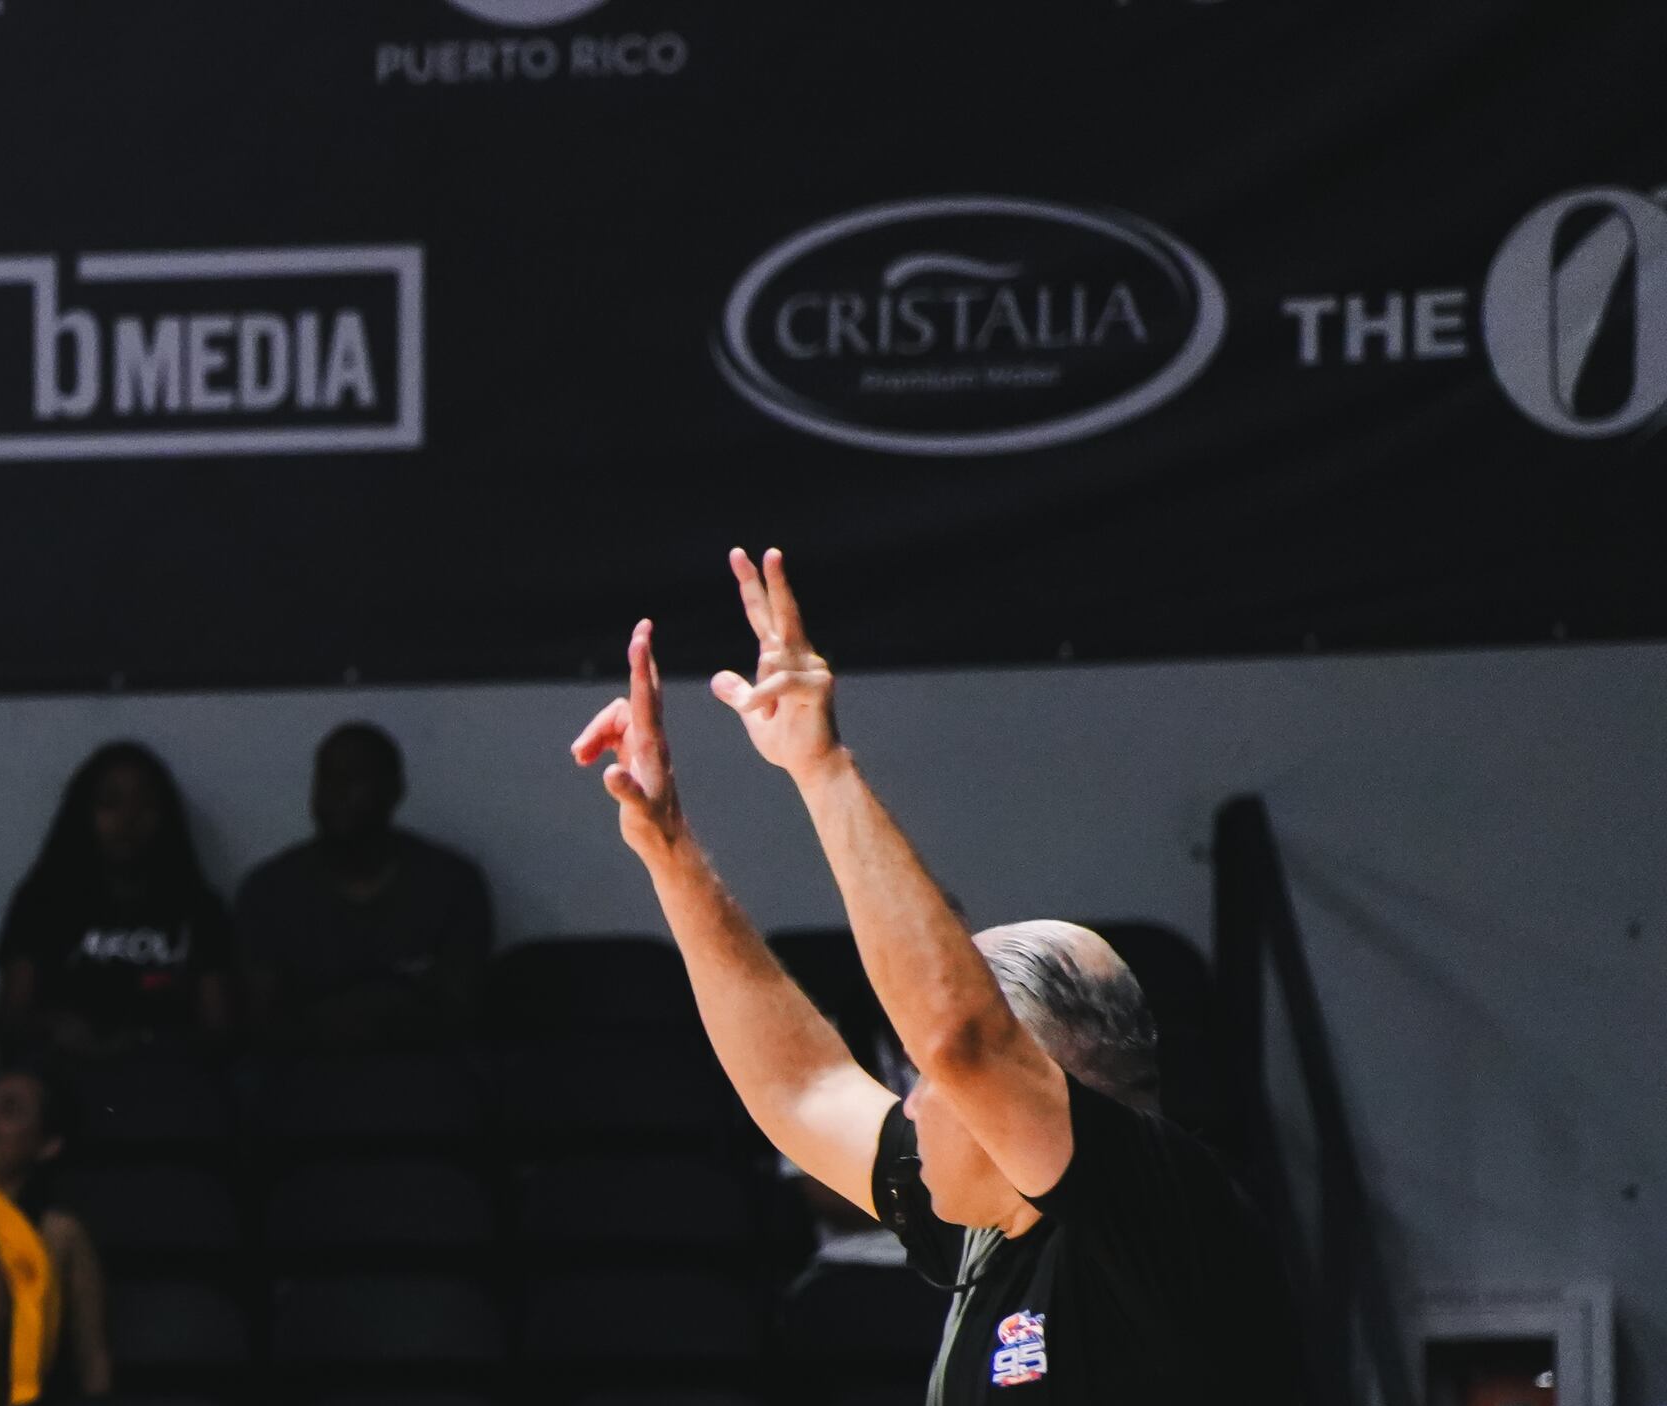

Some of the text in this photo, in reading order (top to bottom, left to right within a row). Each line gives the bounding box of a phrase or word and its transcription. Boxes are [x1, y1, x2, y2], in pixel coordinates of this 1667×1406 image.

[375, 33, 687, 84] PUERTO RICO
[775, 283, 1147, 359] CRISTALIA
[1284, 290, 1467, 364] THE
